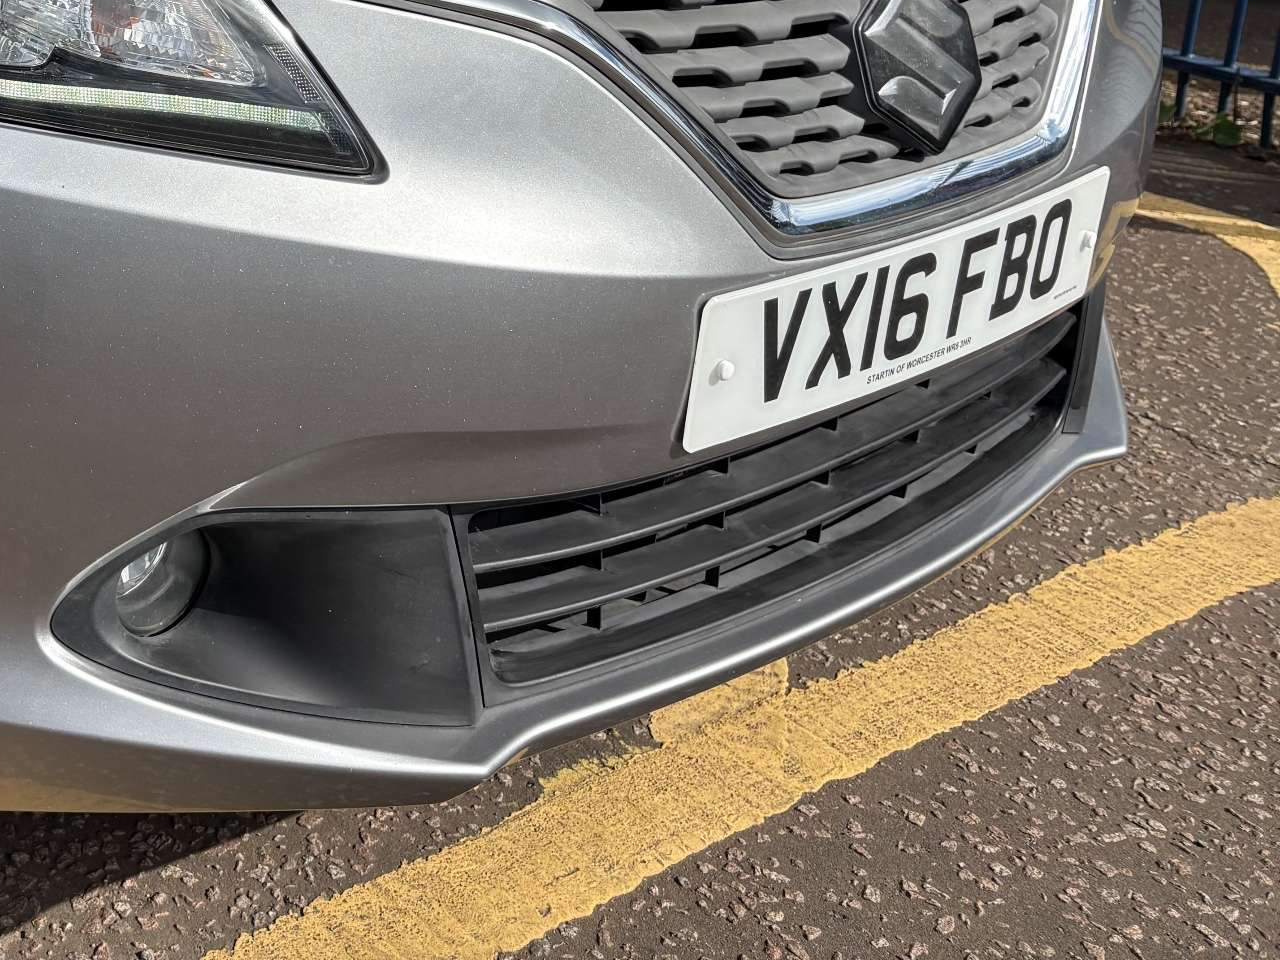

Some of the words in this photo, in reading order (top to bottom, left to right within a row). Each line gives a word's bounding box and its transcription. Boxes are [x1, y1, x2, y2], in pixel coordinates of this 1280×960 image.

[763, 252, 938, 404] VX16
[945, 197, 1073, 340] FBO
[867, 367, 896, 385] STARTIN
[896, 363, 906, 374] OF
[906, 347, 946, 370] WORCESTER
